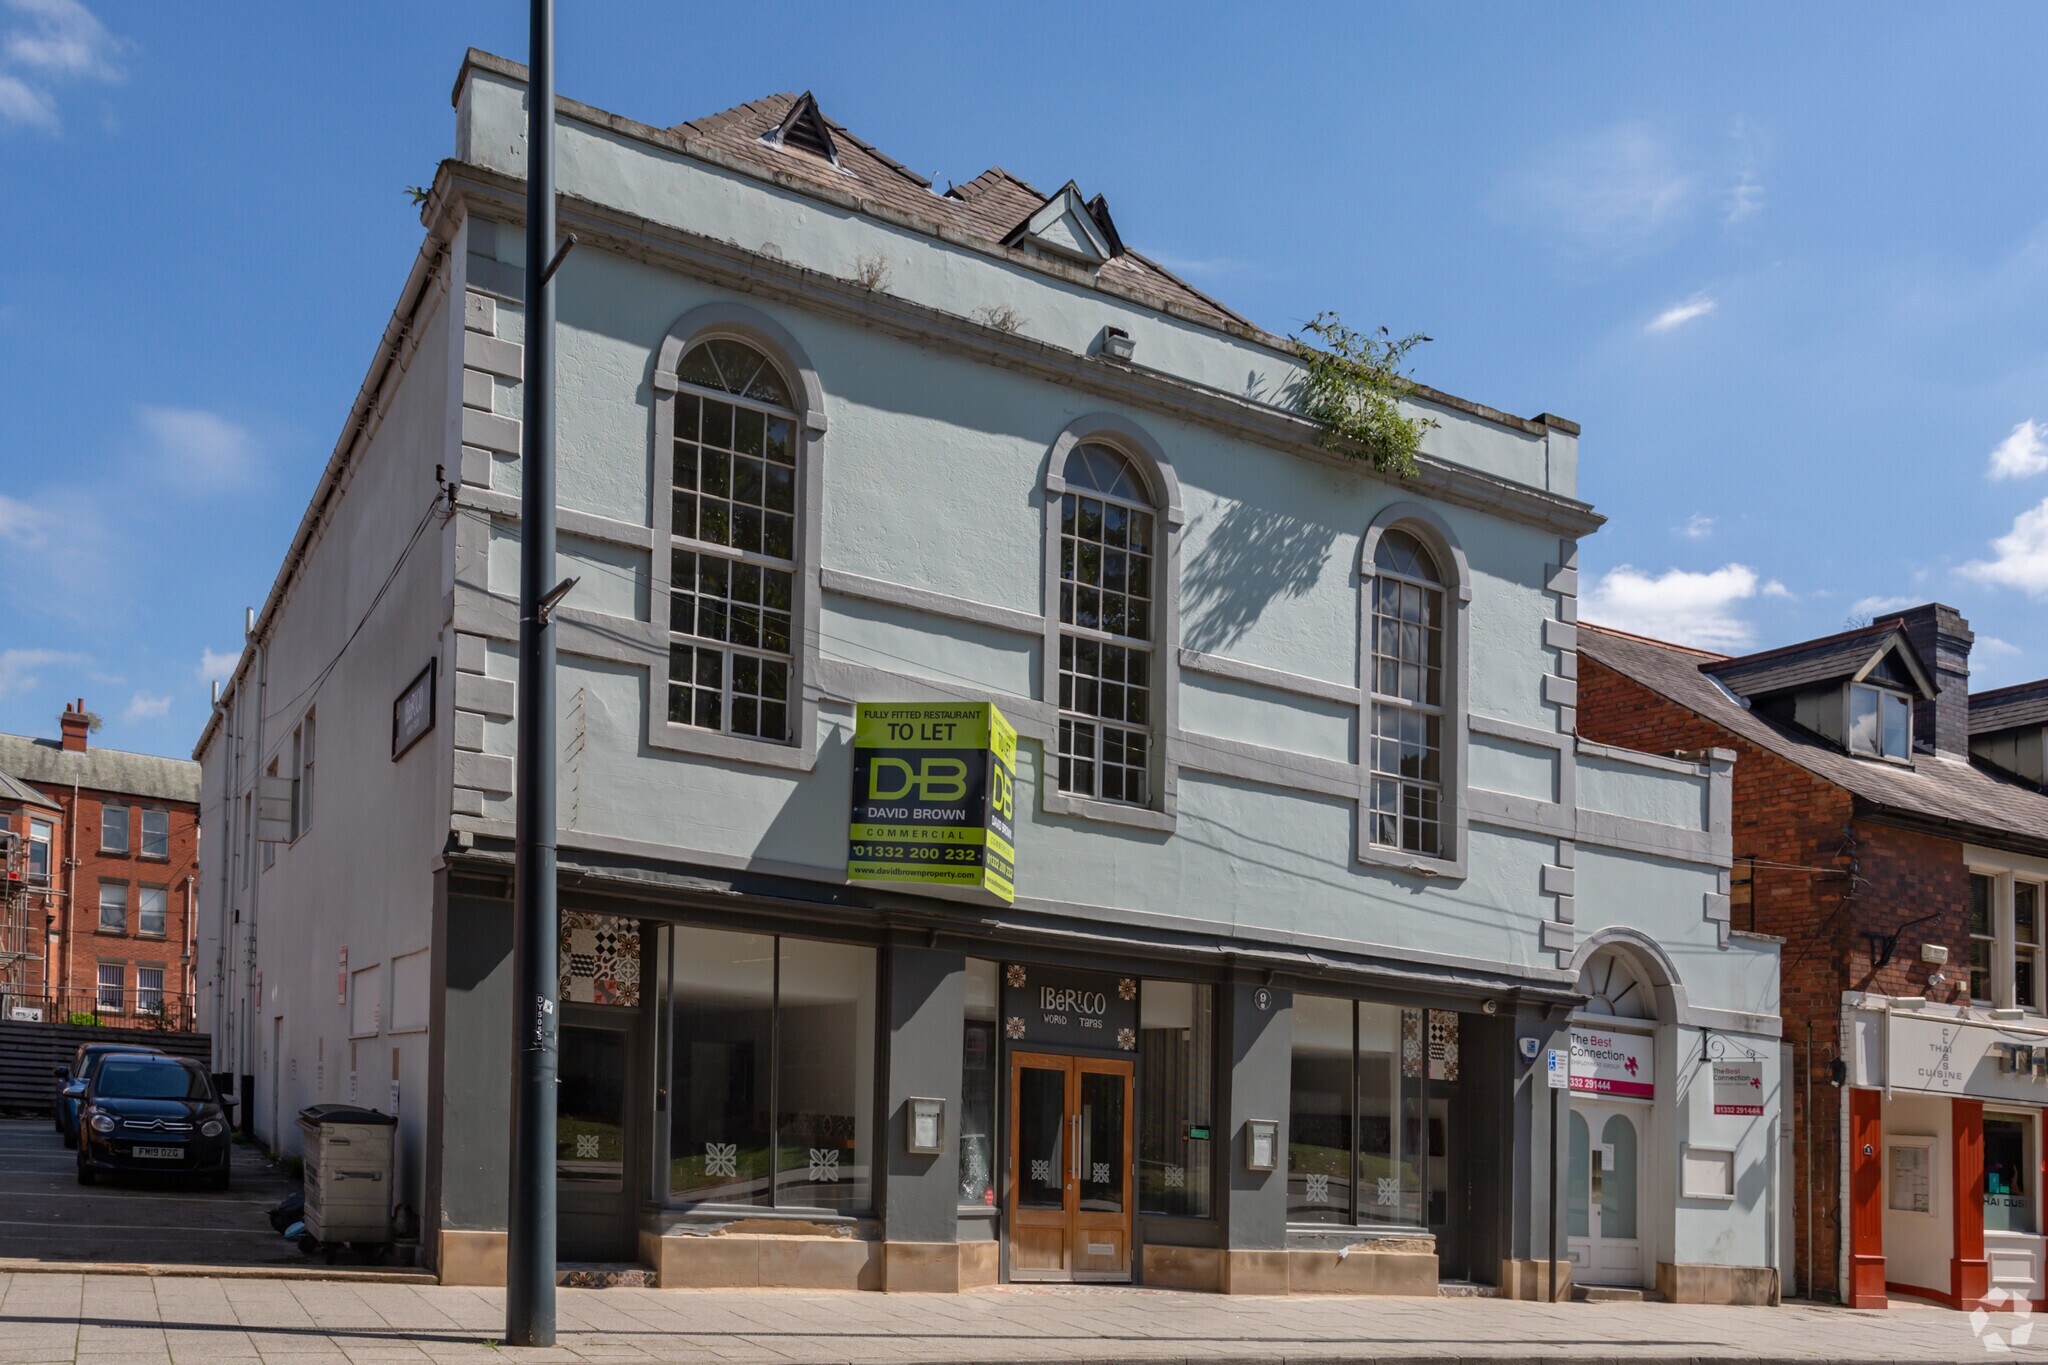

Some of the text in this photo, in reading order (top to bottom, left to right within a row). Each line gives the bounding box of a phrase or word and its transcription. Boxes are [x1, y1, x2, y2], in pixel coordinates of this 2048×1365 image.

[864, 711, 981, 720] FULLY FITTED RESTAURANT
[887, 723, 957, 741] TO LET
[867, 807, 966, 821] DAVID BROWN
[866, 828, 965, 840] COMMERCIAL
[855, 845, 976, 861] 01332 200 232
[854, 867, 975, 879] www.davidbrownproperty.com
[1260, 992, 1267, 1002] 9
[1570, 1033, 1612, 1048] The Best
[1570, 1045, 1625, 1061] Connection
[1929, 1044, 1952, 1053] THAI
[1918, 1068, 1962, 1080] CUISINE
[1584, 1079, 1611, 1090] 291444
[138, 1147, 178, 1157] FM19 OZG
